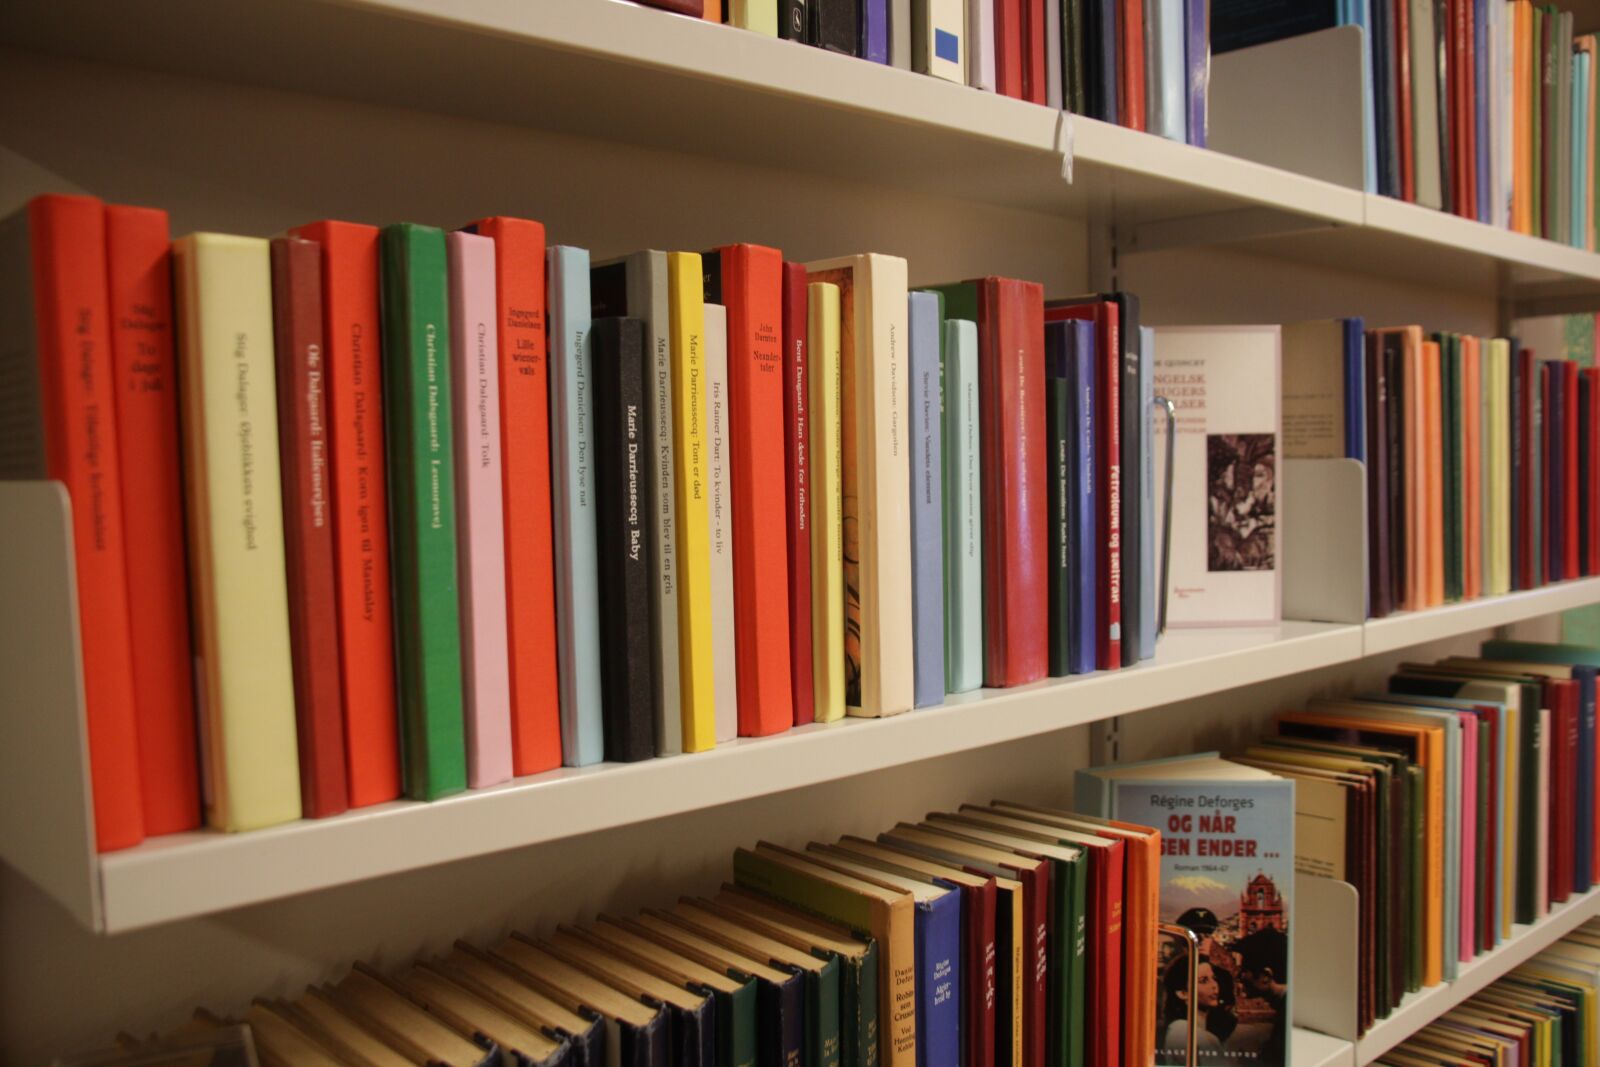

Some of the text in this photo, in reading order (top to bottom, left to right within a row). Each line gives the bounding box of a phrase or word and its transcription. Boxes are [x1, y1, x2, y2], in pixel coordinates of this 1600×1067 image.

[307, 344, 320, 367] Ole
[352, 323, 364, 385] Christian
[427, 323, 437, 382] Christian
[657, 337, 667, 368] Marie
[795, 340, 803, 362] Bent
[713, 382, 721, 398] Iris
[1154, 373, 1206, 384] NGELSK
[477, 322, 490, 468] Christian Dalsgaard: Tolk
[657, 371, 668, 441] Darrieussecq:
[428, 385, 440, 452] Dalsgaard:
[574, 330, 588, 507] Ingegerd Danielsen: Den lyse nat
[690, 334, 701, 500] Marie Darrieussecq: Tom er død
[713, 401, 721, 433] Rainer
[713, 437, 722, 462] Dart:
[798, 442, 806, 467] døde
[660, 445, 670, 489] Kvinden
[714, 466, 721, 479] To
[358, 465, 369, 498] Kom
[627, 405, 641, 560] Marie Darrieussecq: Baby
[714, 481, 722, 520] kvinder
[358, 504, 371, 533] igen
[663, 517, 671, 540] blev
[715, 528, 722, 540] to
[1109, 534, 1119, 548] og
[663, 543, 672, 554] til
[715, 541, 723, 554] liv
[663, 557, 671, 570] en
[362, 558, 375, 622] Mandalay
[663, 573, 673, 595] gris
[1150, 794, 1255, 811] Régine Deforges
[1168, 809, 1237, 834] OG NÅR
[1159, 839, 1191, 857] SEN
[1199, 839, 1258, 858] ENDER
[1174, 863, 1200, 872] Roman
